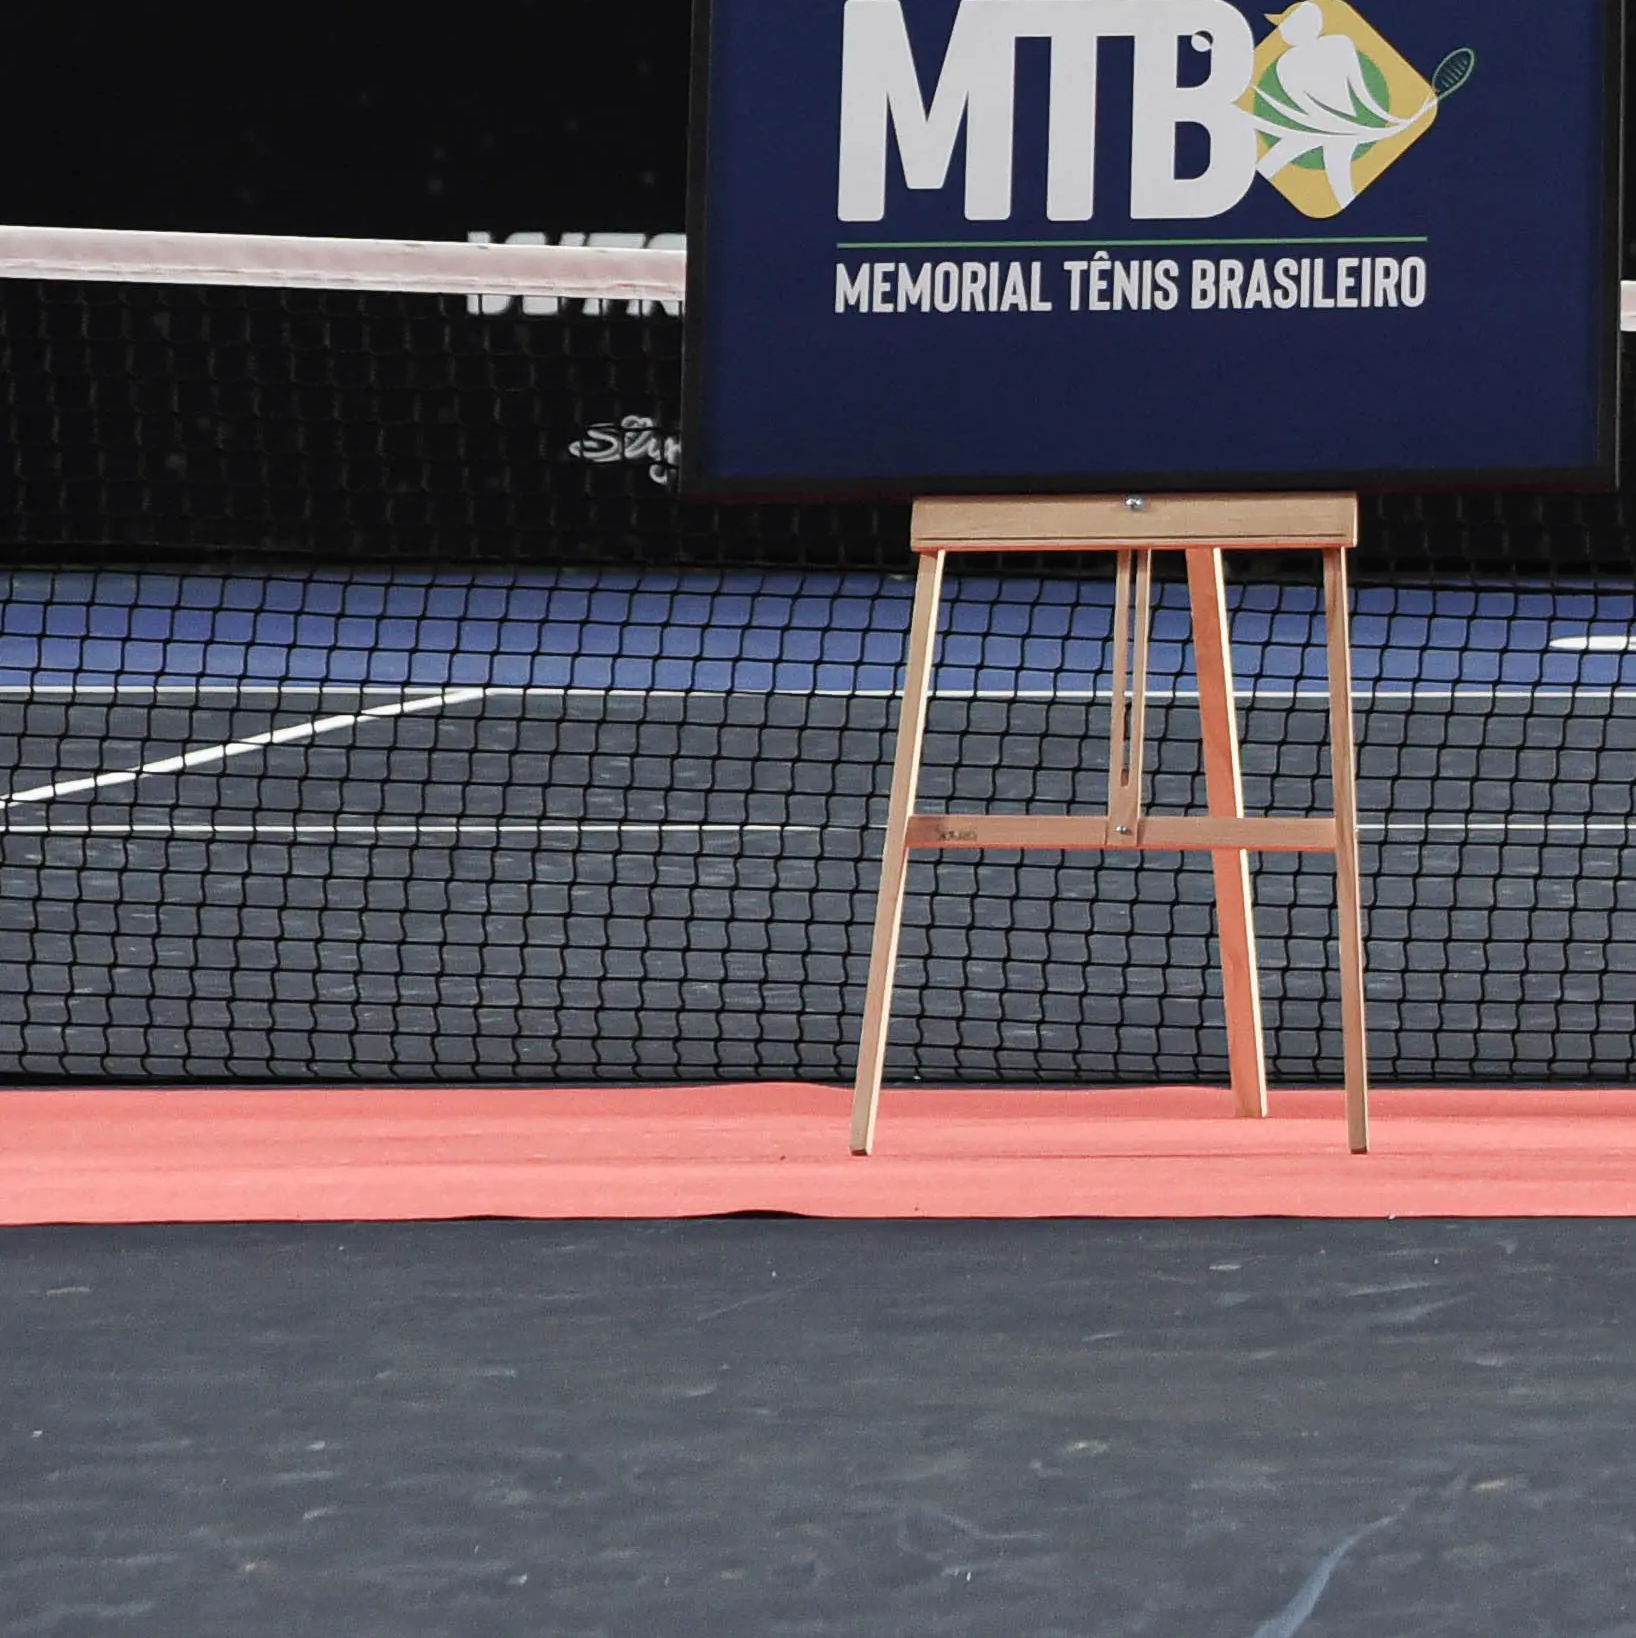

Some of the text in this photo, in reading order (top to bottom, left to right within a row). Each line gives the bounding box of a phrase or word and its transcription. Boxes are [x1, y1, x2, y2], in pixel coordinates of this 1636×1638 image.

[834, 250, 1427, 314] MEMORIAL TÊNIS BRASILEIRO
